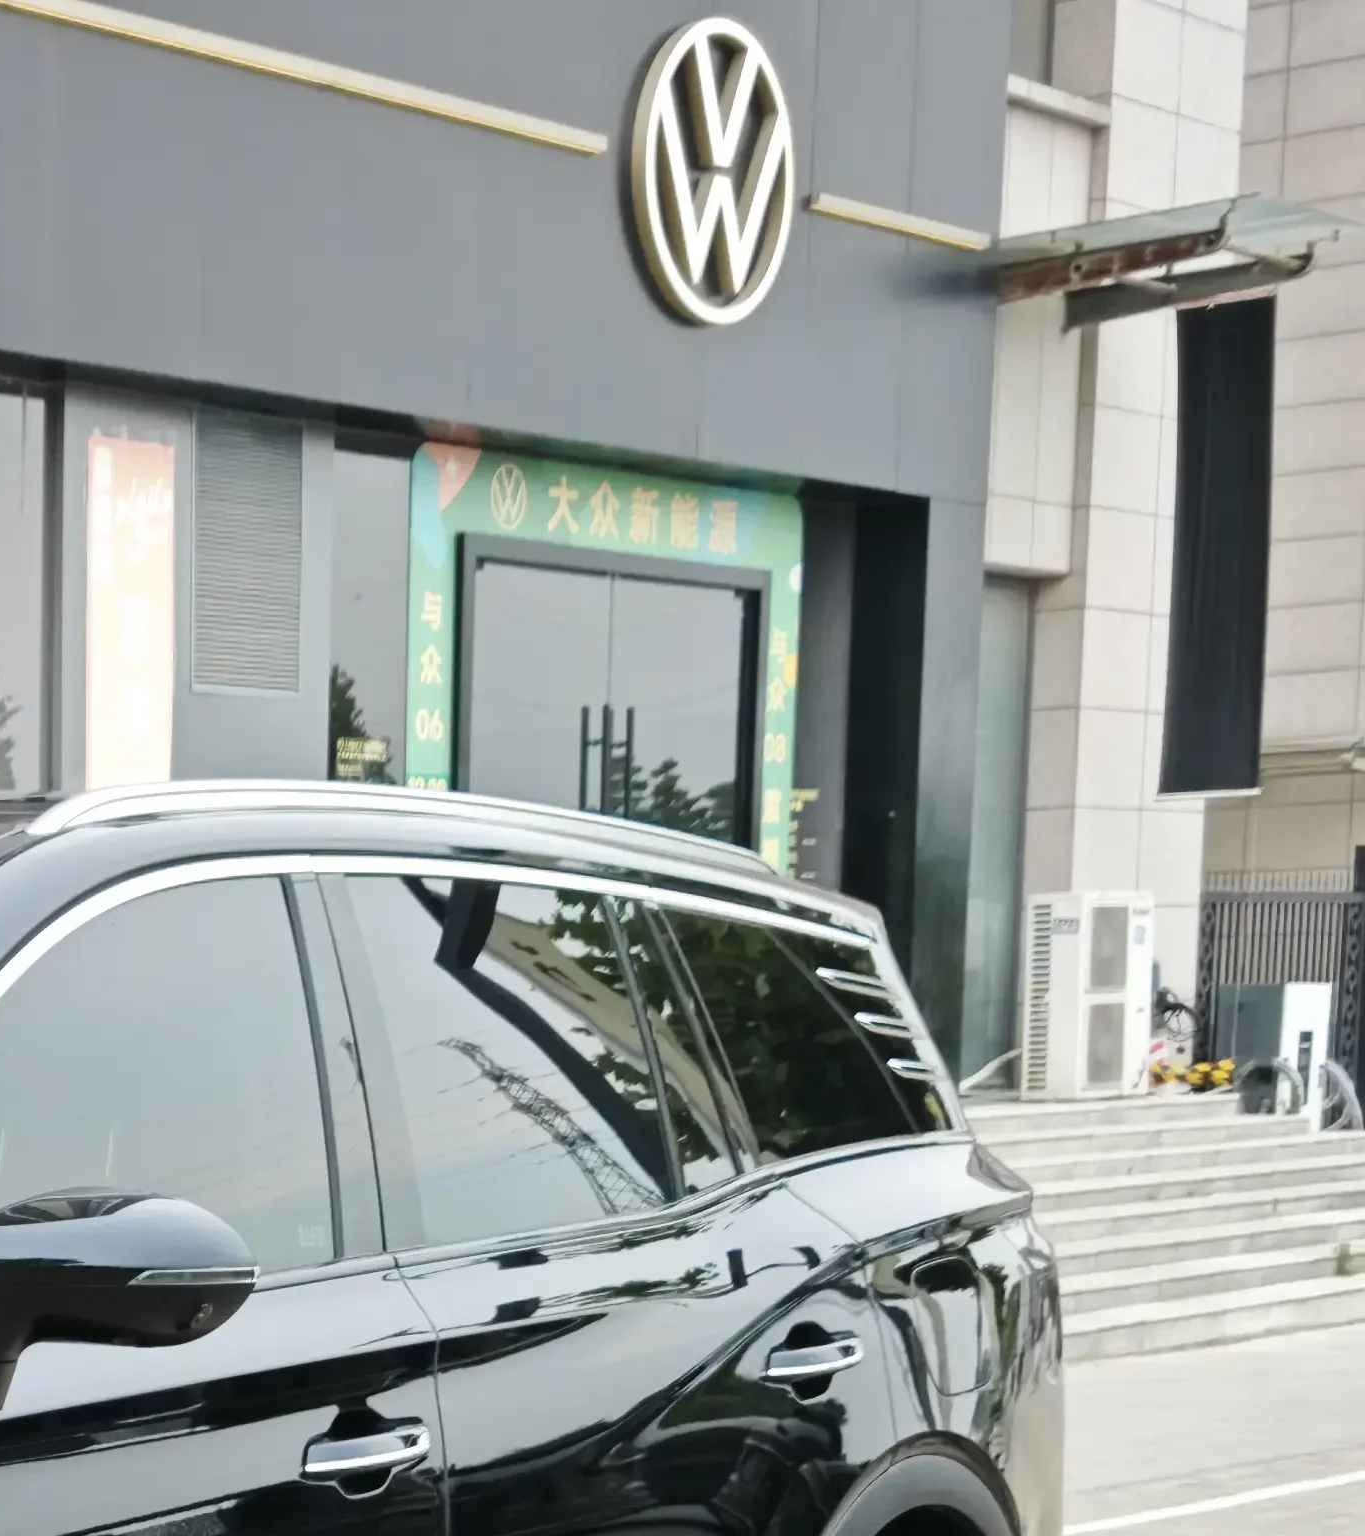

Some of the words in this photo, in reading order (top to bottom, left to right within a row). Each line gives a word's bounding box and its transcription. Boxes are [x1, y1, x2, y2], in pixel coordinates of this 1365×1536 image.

[547, 473, 739, 555] 大众新能源
